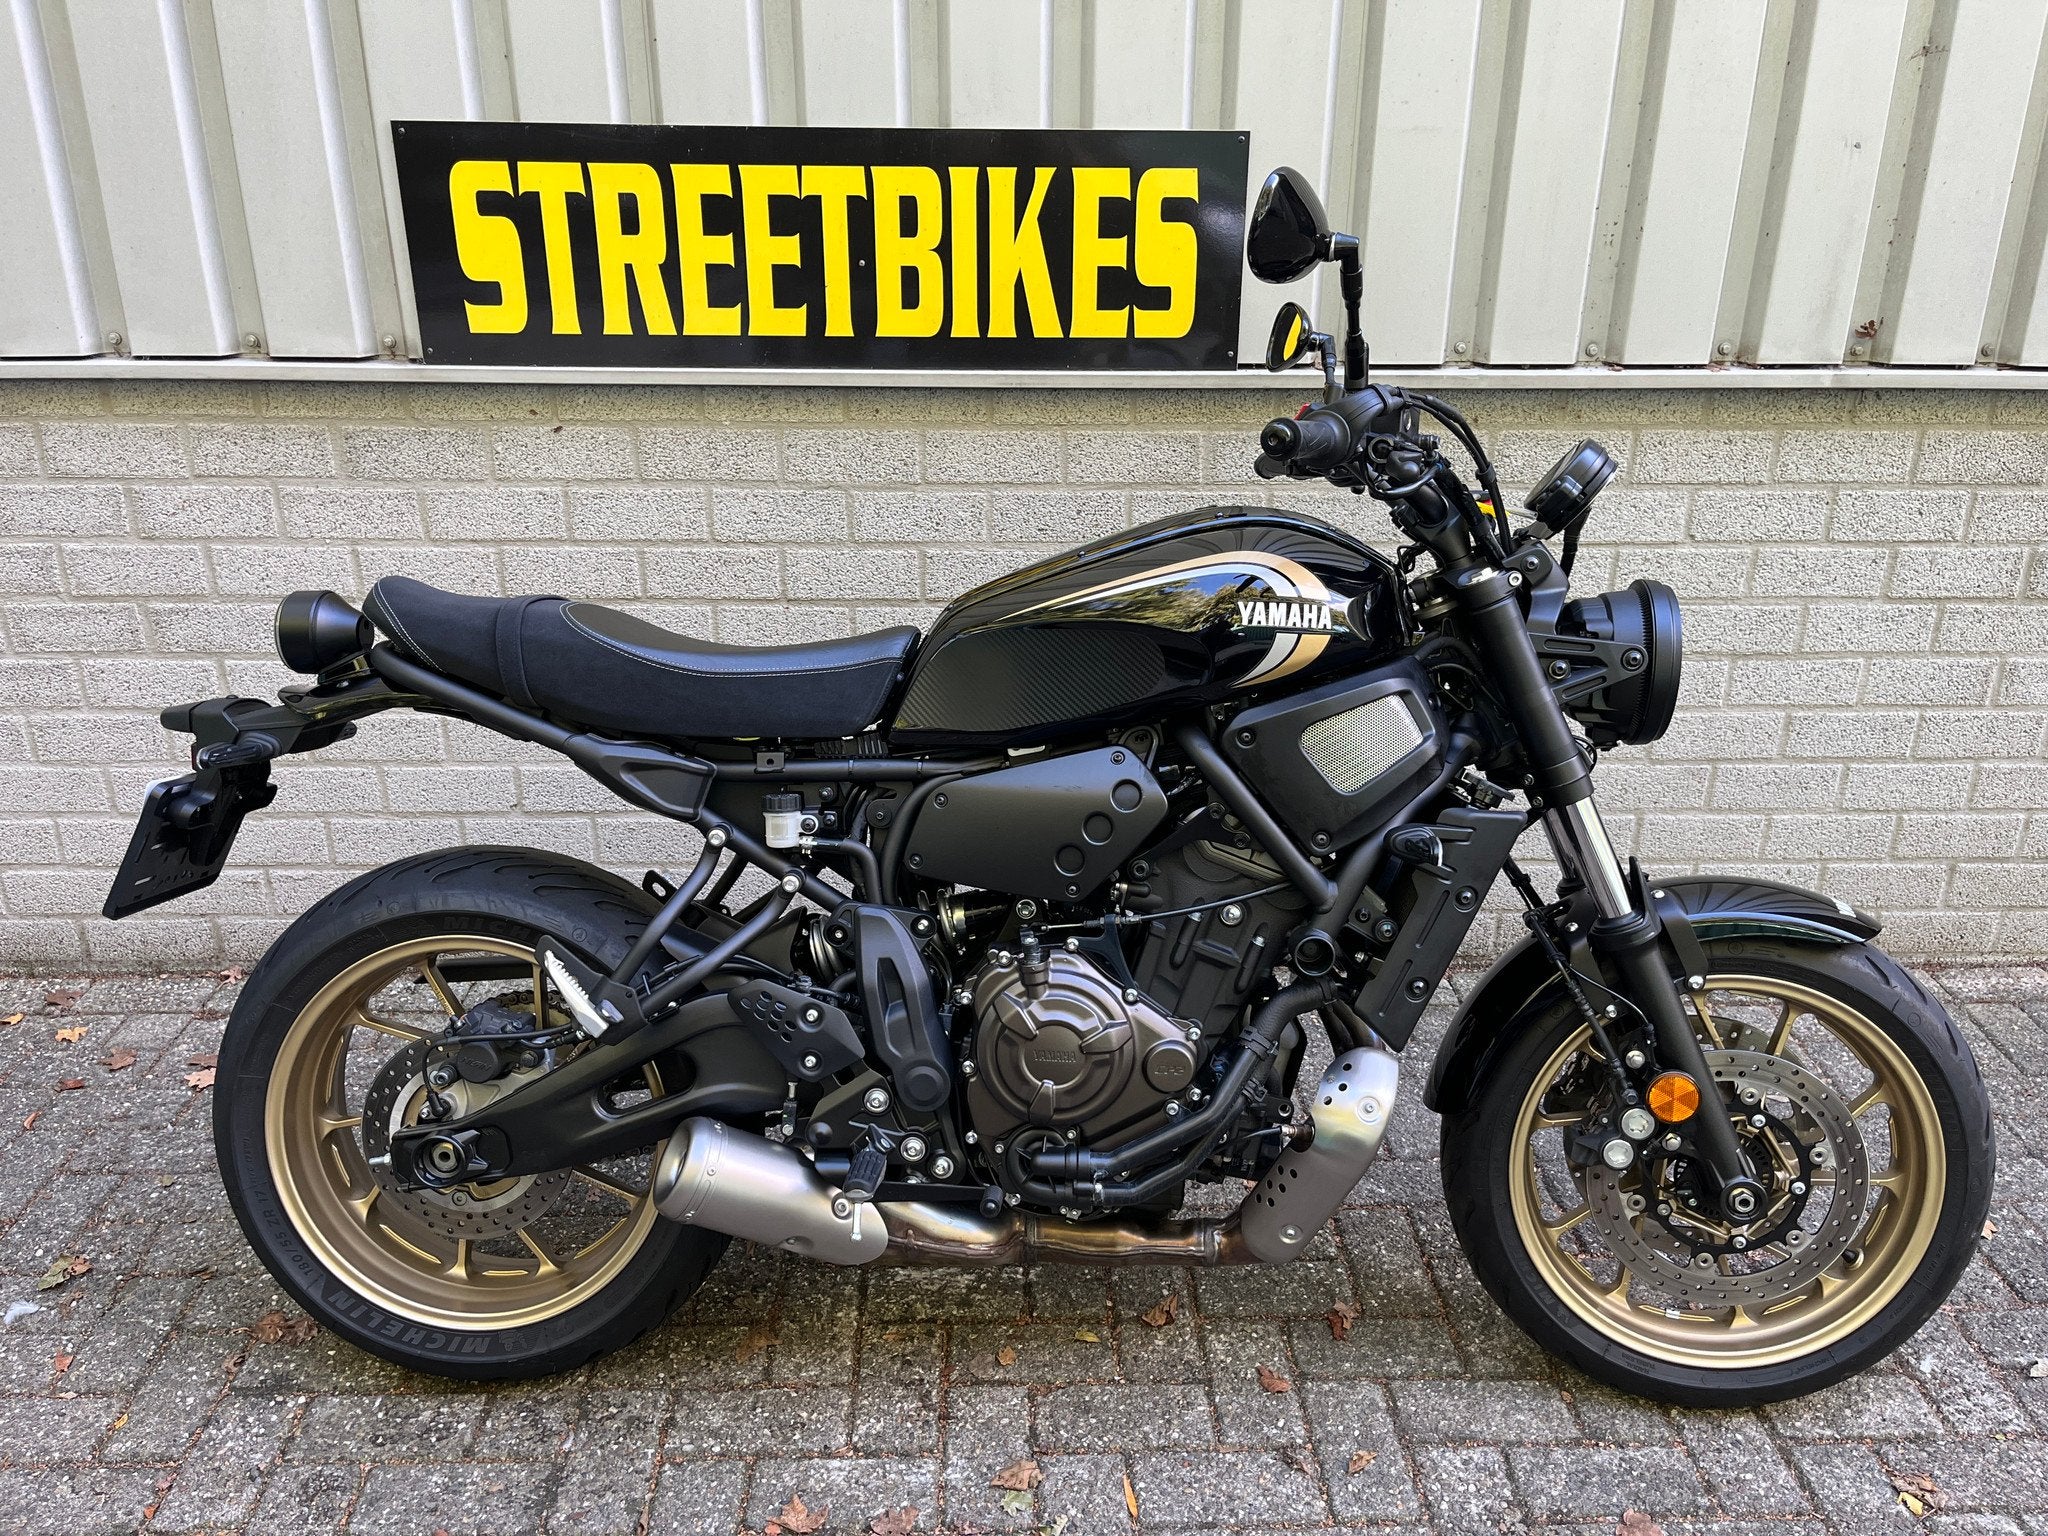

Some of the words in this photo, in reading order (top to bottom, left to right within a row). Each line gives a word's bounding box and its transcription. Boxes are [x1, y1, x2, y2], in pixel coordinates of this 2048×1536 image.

[448, 160, 1200, 339] STREETBIKES
[1237, 601, 1332, 630] YAMAHA
[1032, 1049, 1076, 1063] YAMAHA
[263, 1208, 280, 1228] ZR
[275, 1231, 314, 1276] 180/55
[328, 1290, 492, 1354] MICHELIN
